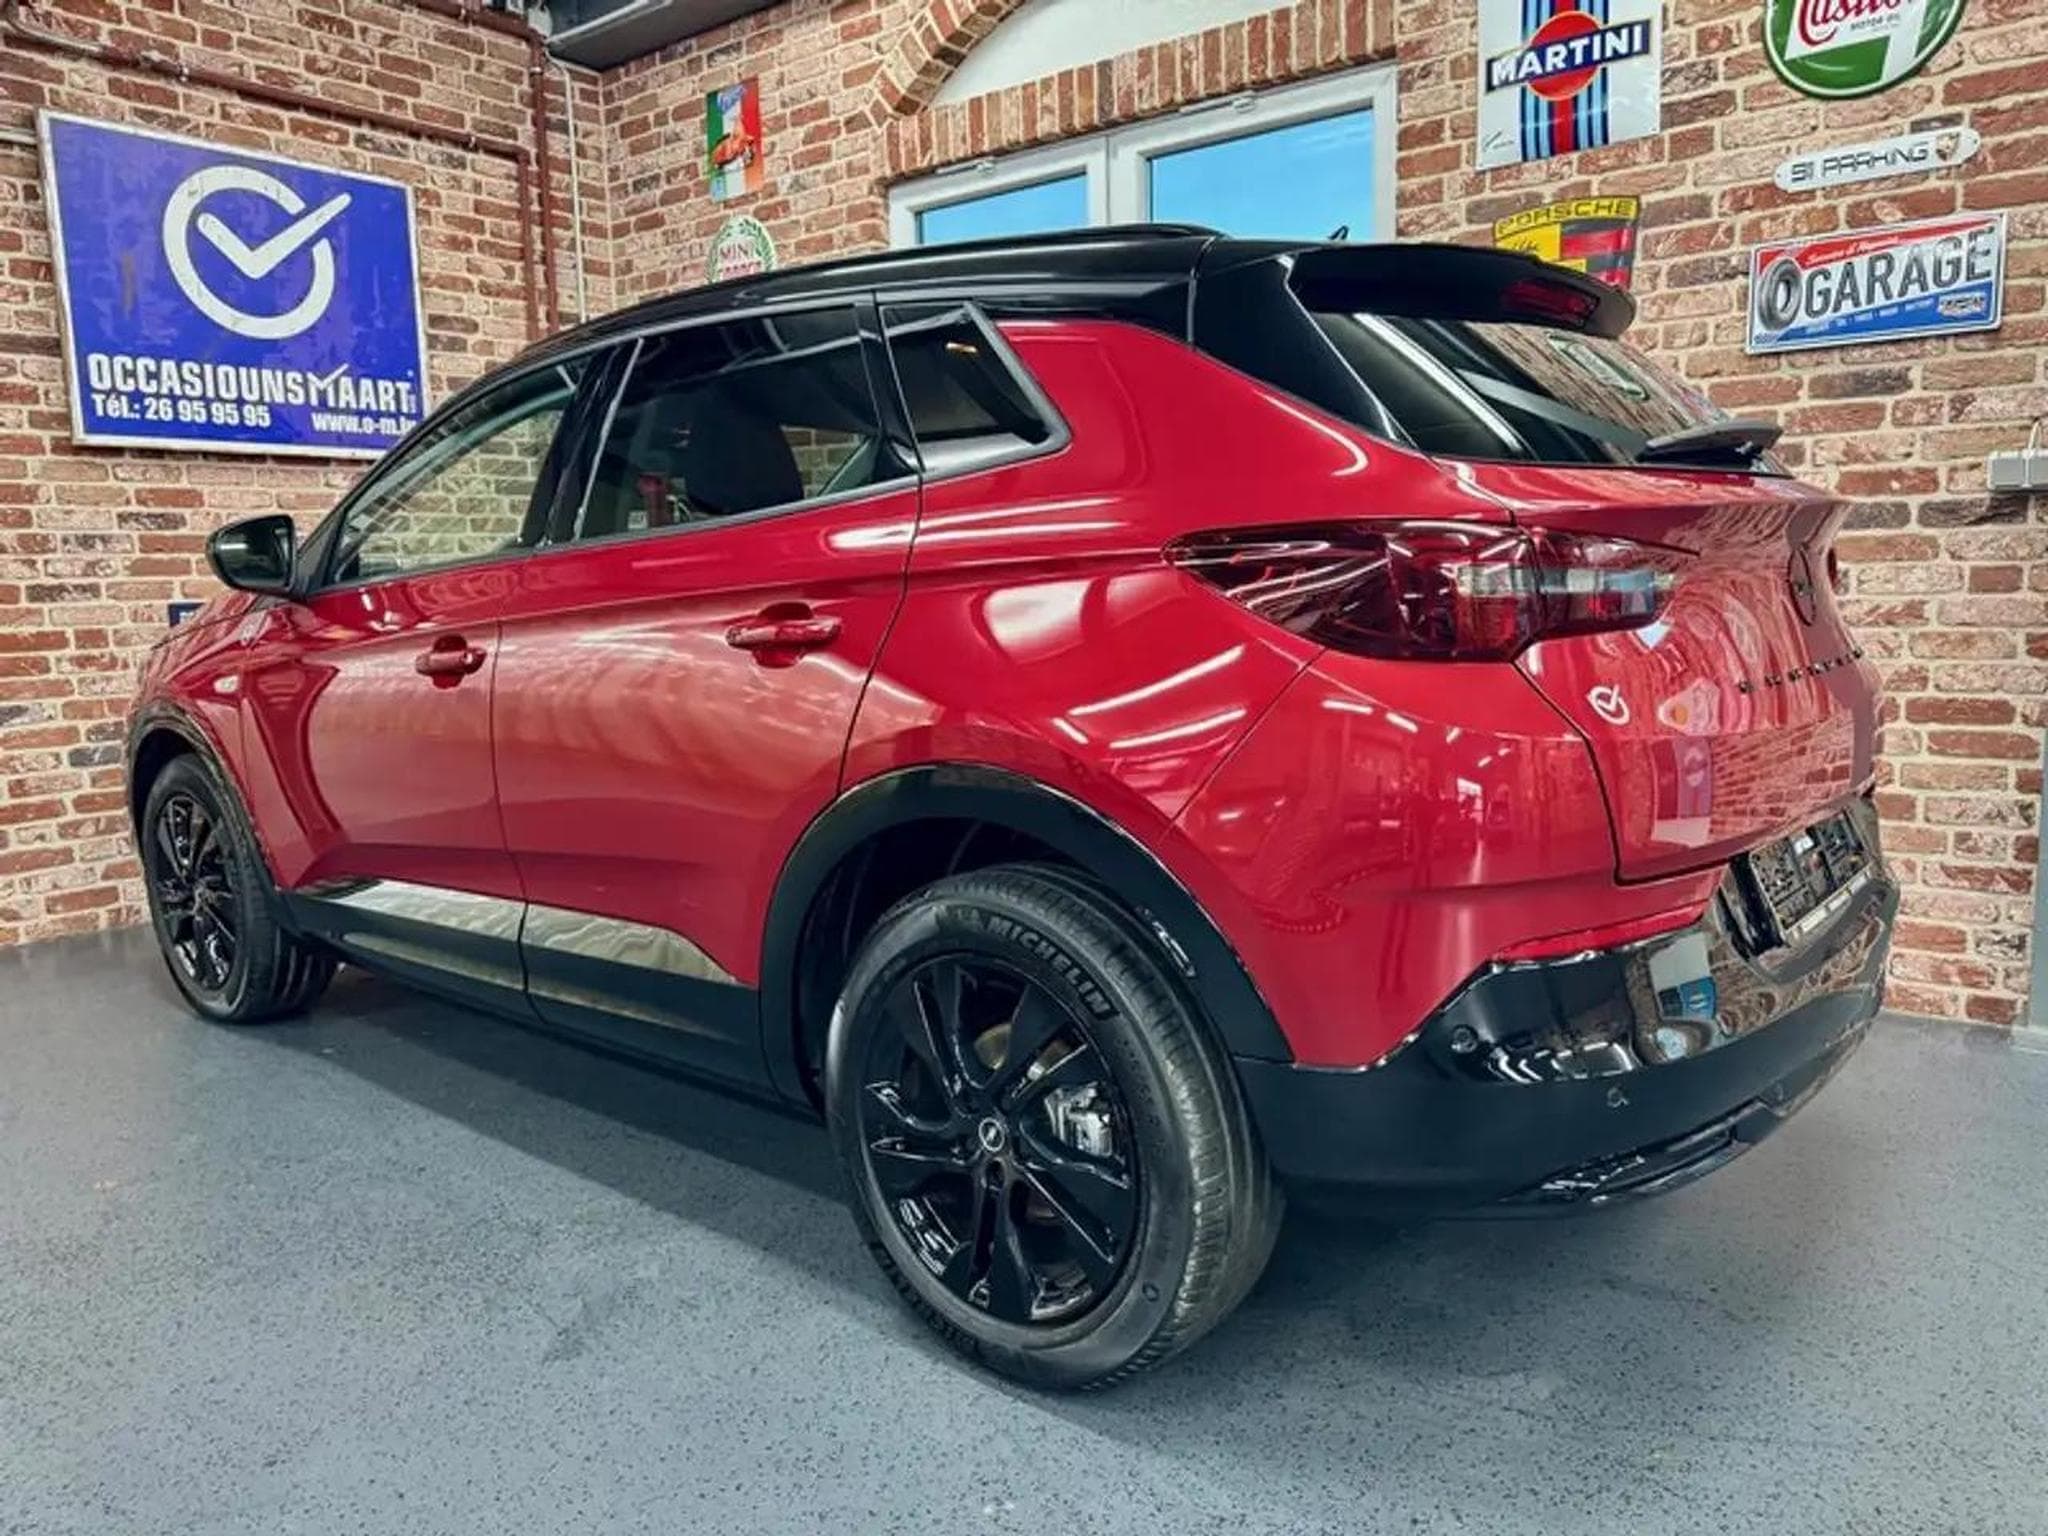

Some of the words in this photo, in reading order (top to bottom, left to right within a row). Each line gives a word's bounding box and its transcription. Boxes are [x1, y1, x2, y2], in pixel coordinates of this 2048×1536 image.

[1491, 24, 1643, 87] MARTINI
[1821, 141, 1928, 178] PARKING
[1499, 200, 1633, 235] PORSCHE
[1804, 225, 1994, 319] GARAGE
[87, 352, 412, 414] OCCASIOUNSMAART
[143, 396, 174, 422] 26
[177, 399, 207, 425] 95
[210, 401, 240, 427] 95
[242, 403, 272, 428] 95
[986, 915, 1112, 1016] MICHELIN
